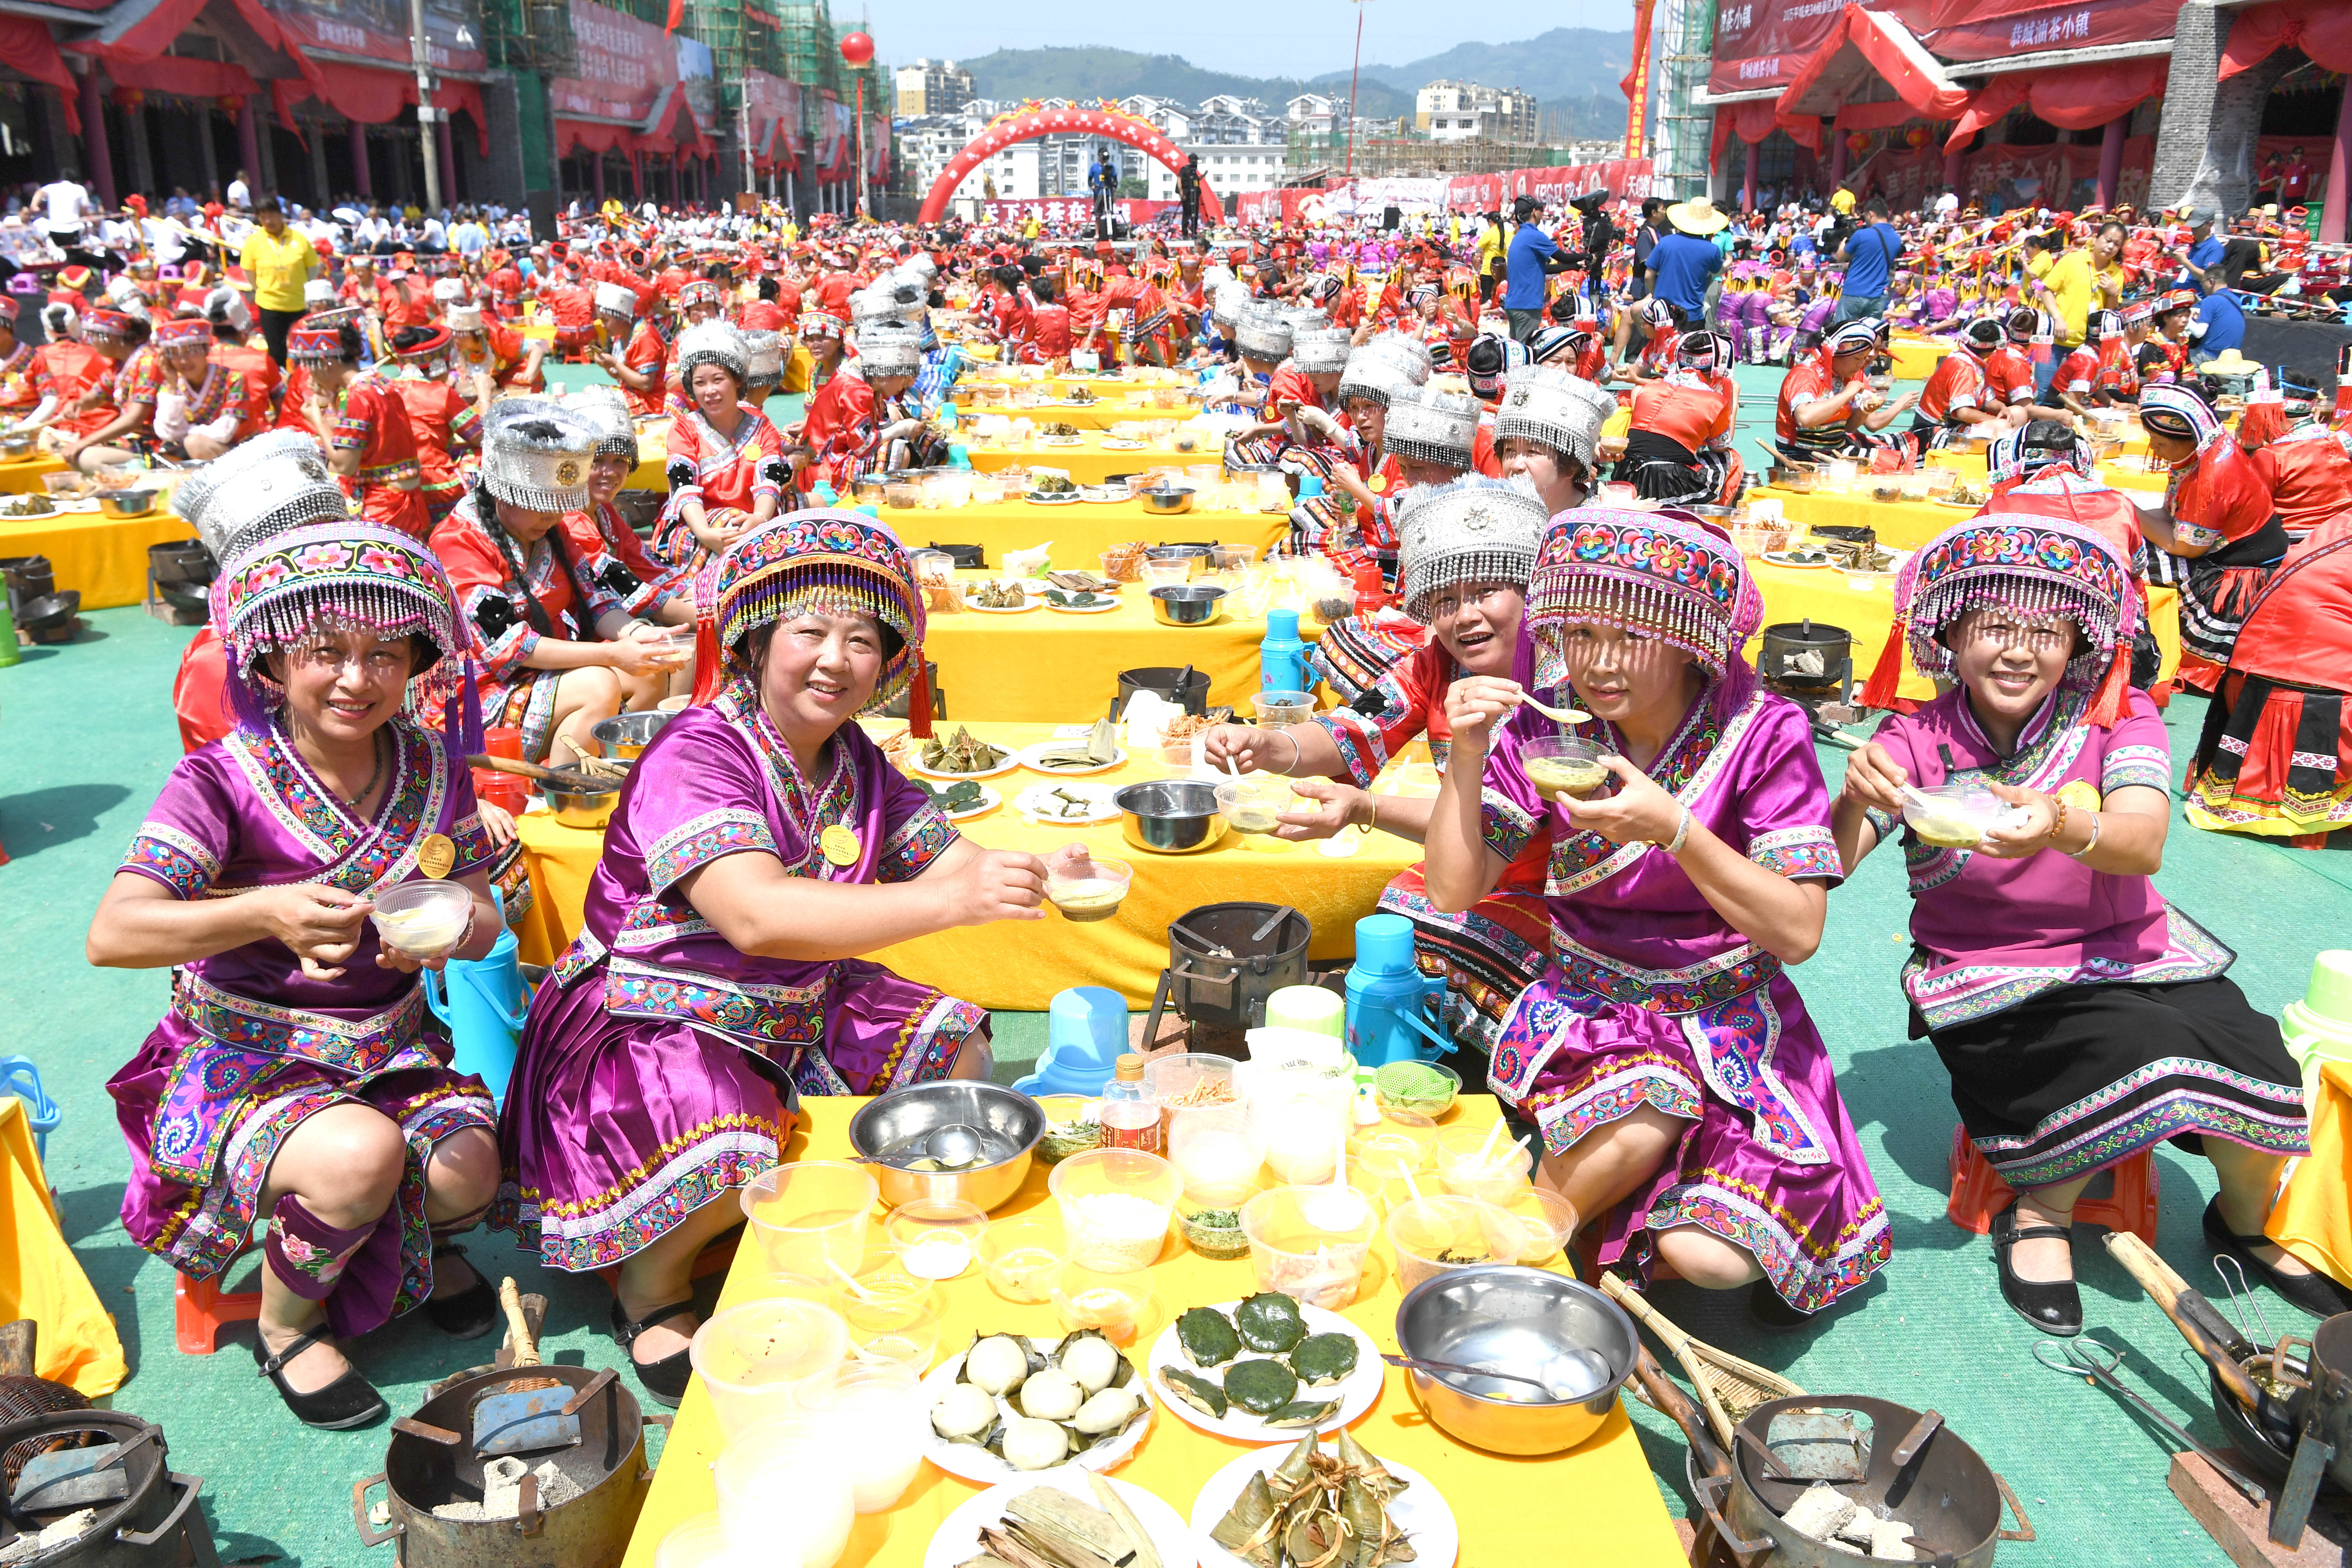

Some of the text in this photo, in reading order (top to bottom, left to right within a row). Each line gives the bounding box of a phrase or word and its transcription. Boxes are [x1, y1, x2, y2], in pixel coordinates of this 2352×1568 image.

[2009, 11, 2091, 48] 恭城油茶小镇
